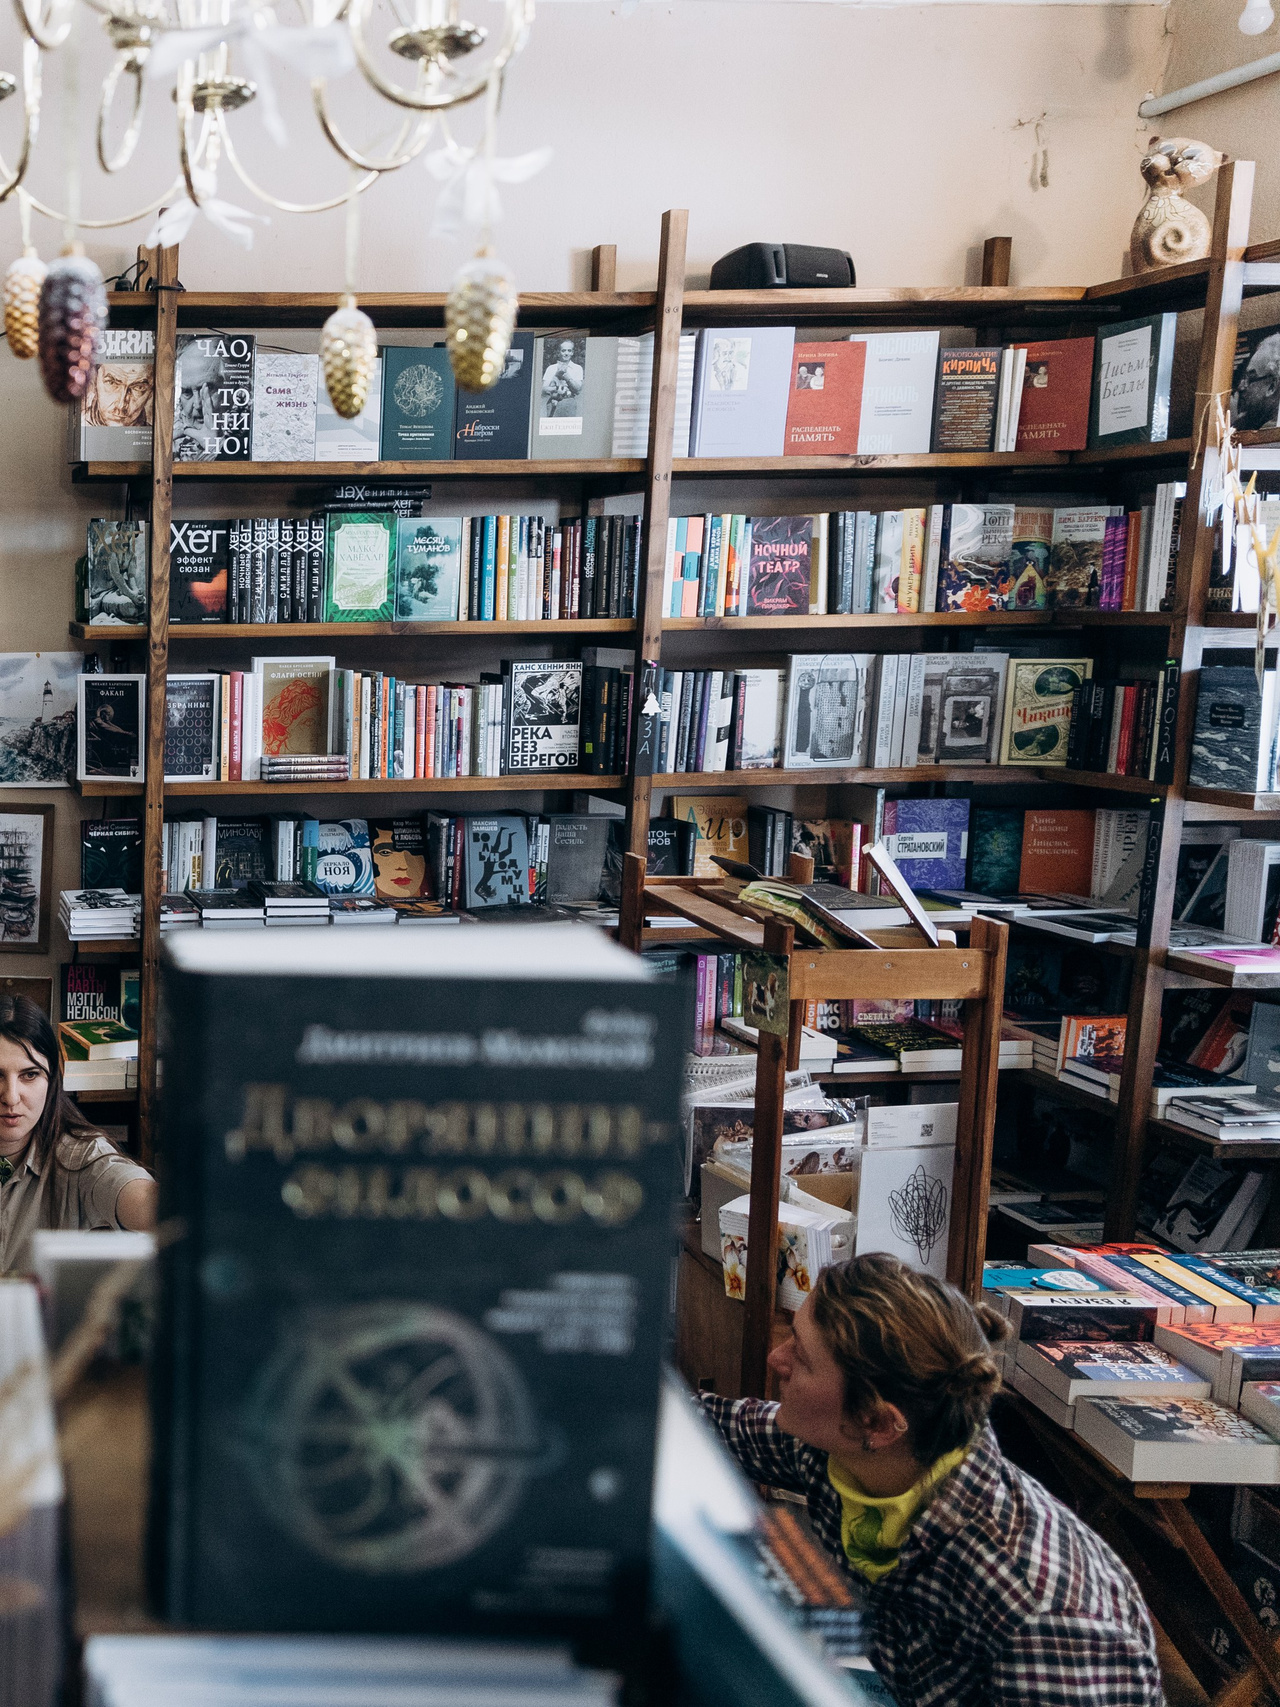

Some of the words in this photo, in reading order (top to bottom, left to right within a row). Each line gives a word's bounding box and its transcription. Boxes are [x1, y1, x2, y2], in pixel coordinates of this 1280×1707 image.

[942, 357, 997, 374] КИРПИЧА
[791, 433, 835, 442] ПАМЯТЬ
[754, 541, 808, 557] НОЧНОЙ
[758, 560, 800, 574] ТЕАТР
[511, 726, 553, 740] РЕКА
[511, 740, 538, 754] БЕЗ
[510, 753, 578, 767] БЕРЕГОВ
[324, 866, 350, 876] НОЯ
[66, 992, 104, 1006] МЭГГИ
[66, 1006, 118, 1020] НЕЛЬСОН
